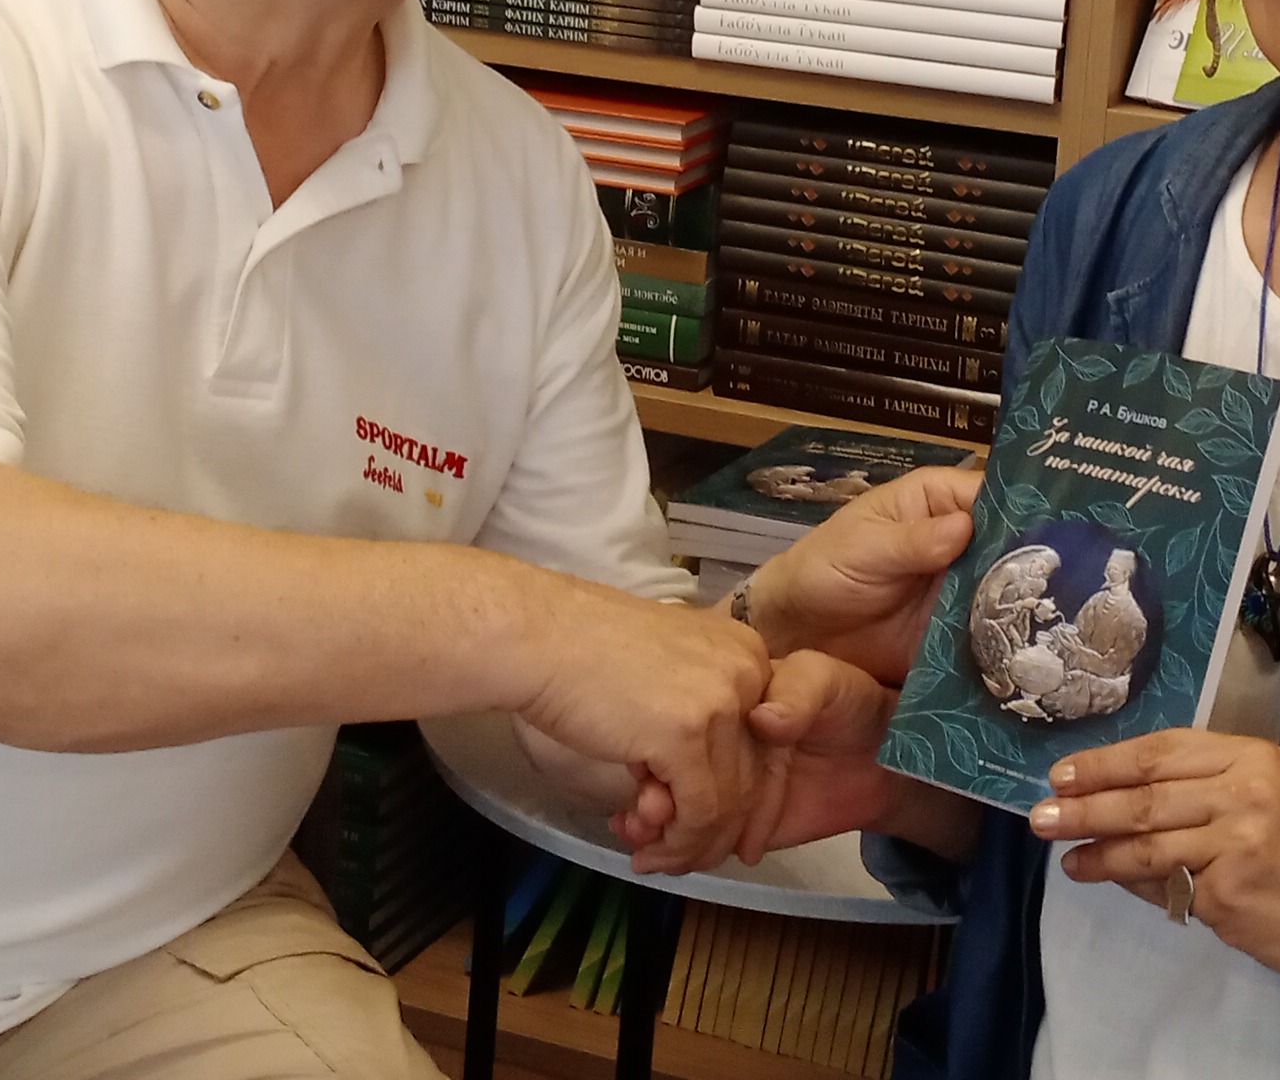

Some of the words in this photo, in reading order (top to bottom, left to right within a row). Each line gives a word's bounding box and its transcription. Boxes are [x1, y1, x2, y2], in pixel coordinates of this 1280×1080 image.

[550, 1, 589, 14] КАРИМ
[505, 23, 543, 36] ФАТИХ
[548, 29, 587, 42] КАРИМ
[765, 289, 806, 309] ТАТАР
[891, 310, 947, 332] ТАРИХЫ
[767, 330, 807, 347] ТАТАР
[894, 351, 950, 372] ТАРИХЫ
[884, 397, 940, 419] ТАРИХЫ
[1087, 399, 1098, 414] Р.
[1100, 403, 1113, 417] А.
[1117, 406, 1167, 429] Бушков
[356, 416, 468, 479] SPORTALM
[1027, 416, 1071, 457] За
[1074, 432, 1152, 462] чашкой
[1157, 451, 1195, 473] чая
[363, 455, 403, 493] Seefeld
[1044, 455, 1202, 509] по-татарски
